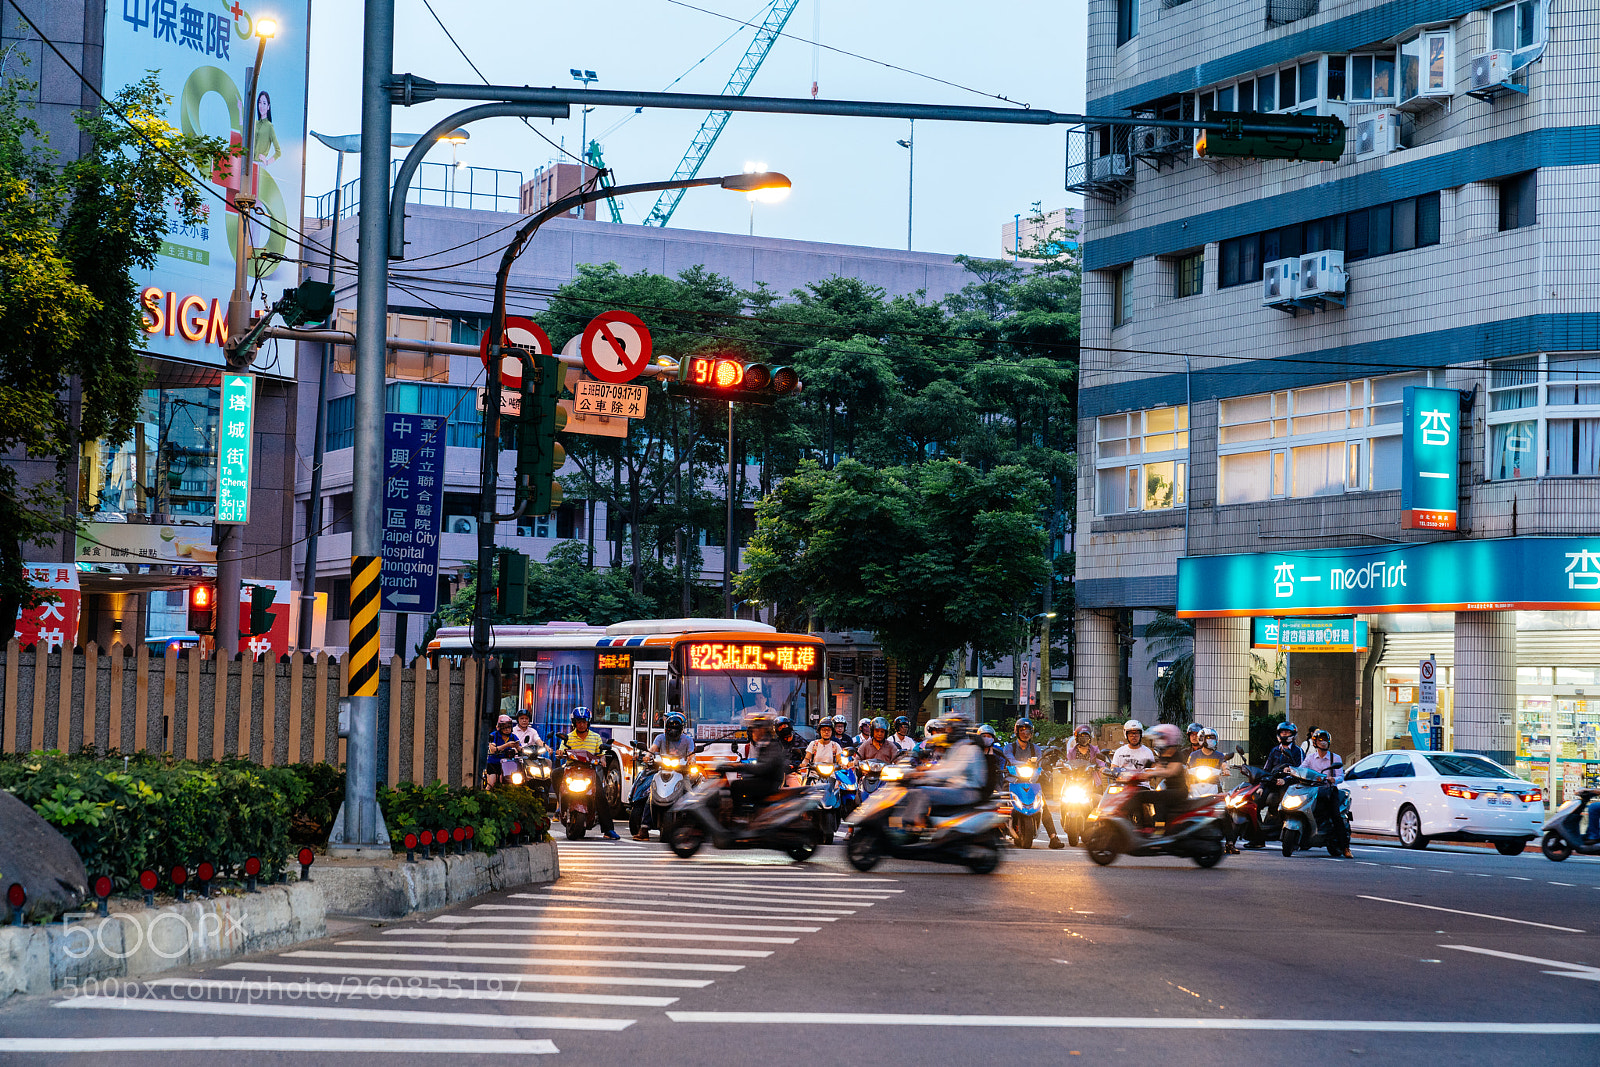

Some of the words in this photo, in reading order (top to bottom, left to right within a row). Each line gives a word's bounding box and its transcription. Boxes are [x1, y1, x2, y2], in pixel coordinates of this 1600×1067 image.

[123, 0, 230, 61] 中保無限
[579, 398, 640, 415] 公車除外
[227, 394, 246, 465] 塔城街
[1419, 408, 1451, 479] 杏一
[222, 466, 232, 476] Ta
[386, 417, 412, 529] 中興院區
[414, 418, 438, 531] 臺北市立聯合醫院
[221, 478, 246, 489] Cheng
[221, 488, 233, 498] St.
[221, 499, 233, 507] 36
[235, 499, 245, 507] 13
[220, 512, 232, 521] 30
[237, 512, 243, 521] 7
[381, 528, 413, 543] Taipei
[415, 530, 437, 547] City
[82, 546, 101, 557] 餐食
[110, 547, 129, 558] 咖啡
[138, 548, 158, 558] 甜點
[380, 559, 434, 576] Zhongxing
[1564, 548, 1600, 590] 杏
[380, 574, 417, 588] Branch
[1273, 561, 1322, 598] 杏一
[1330, 559, 1408, 590] medFirst
[723, 644, 762, 665] 北門
[776, 646, 815, 666] 南港
